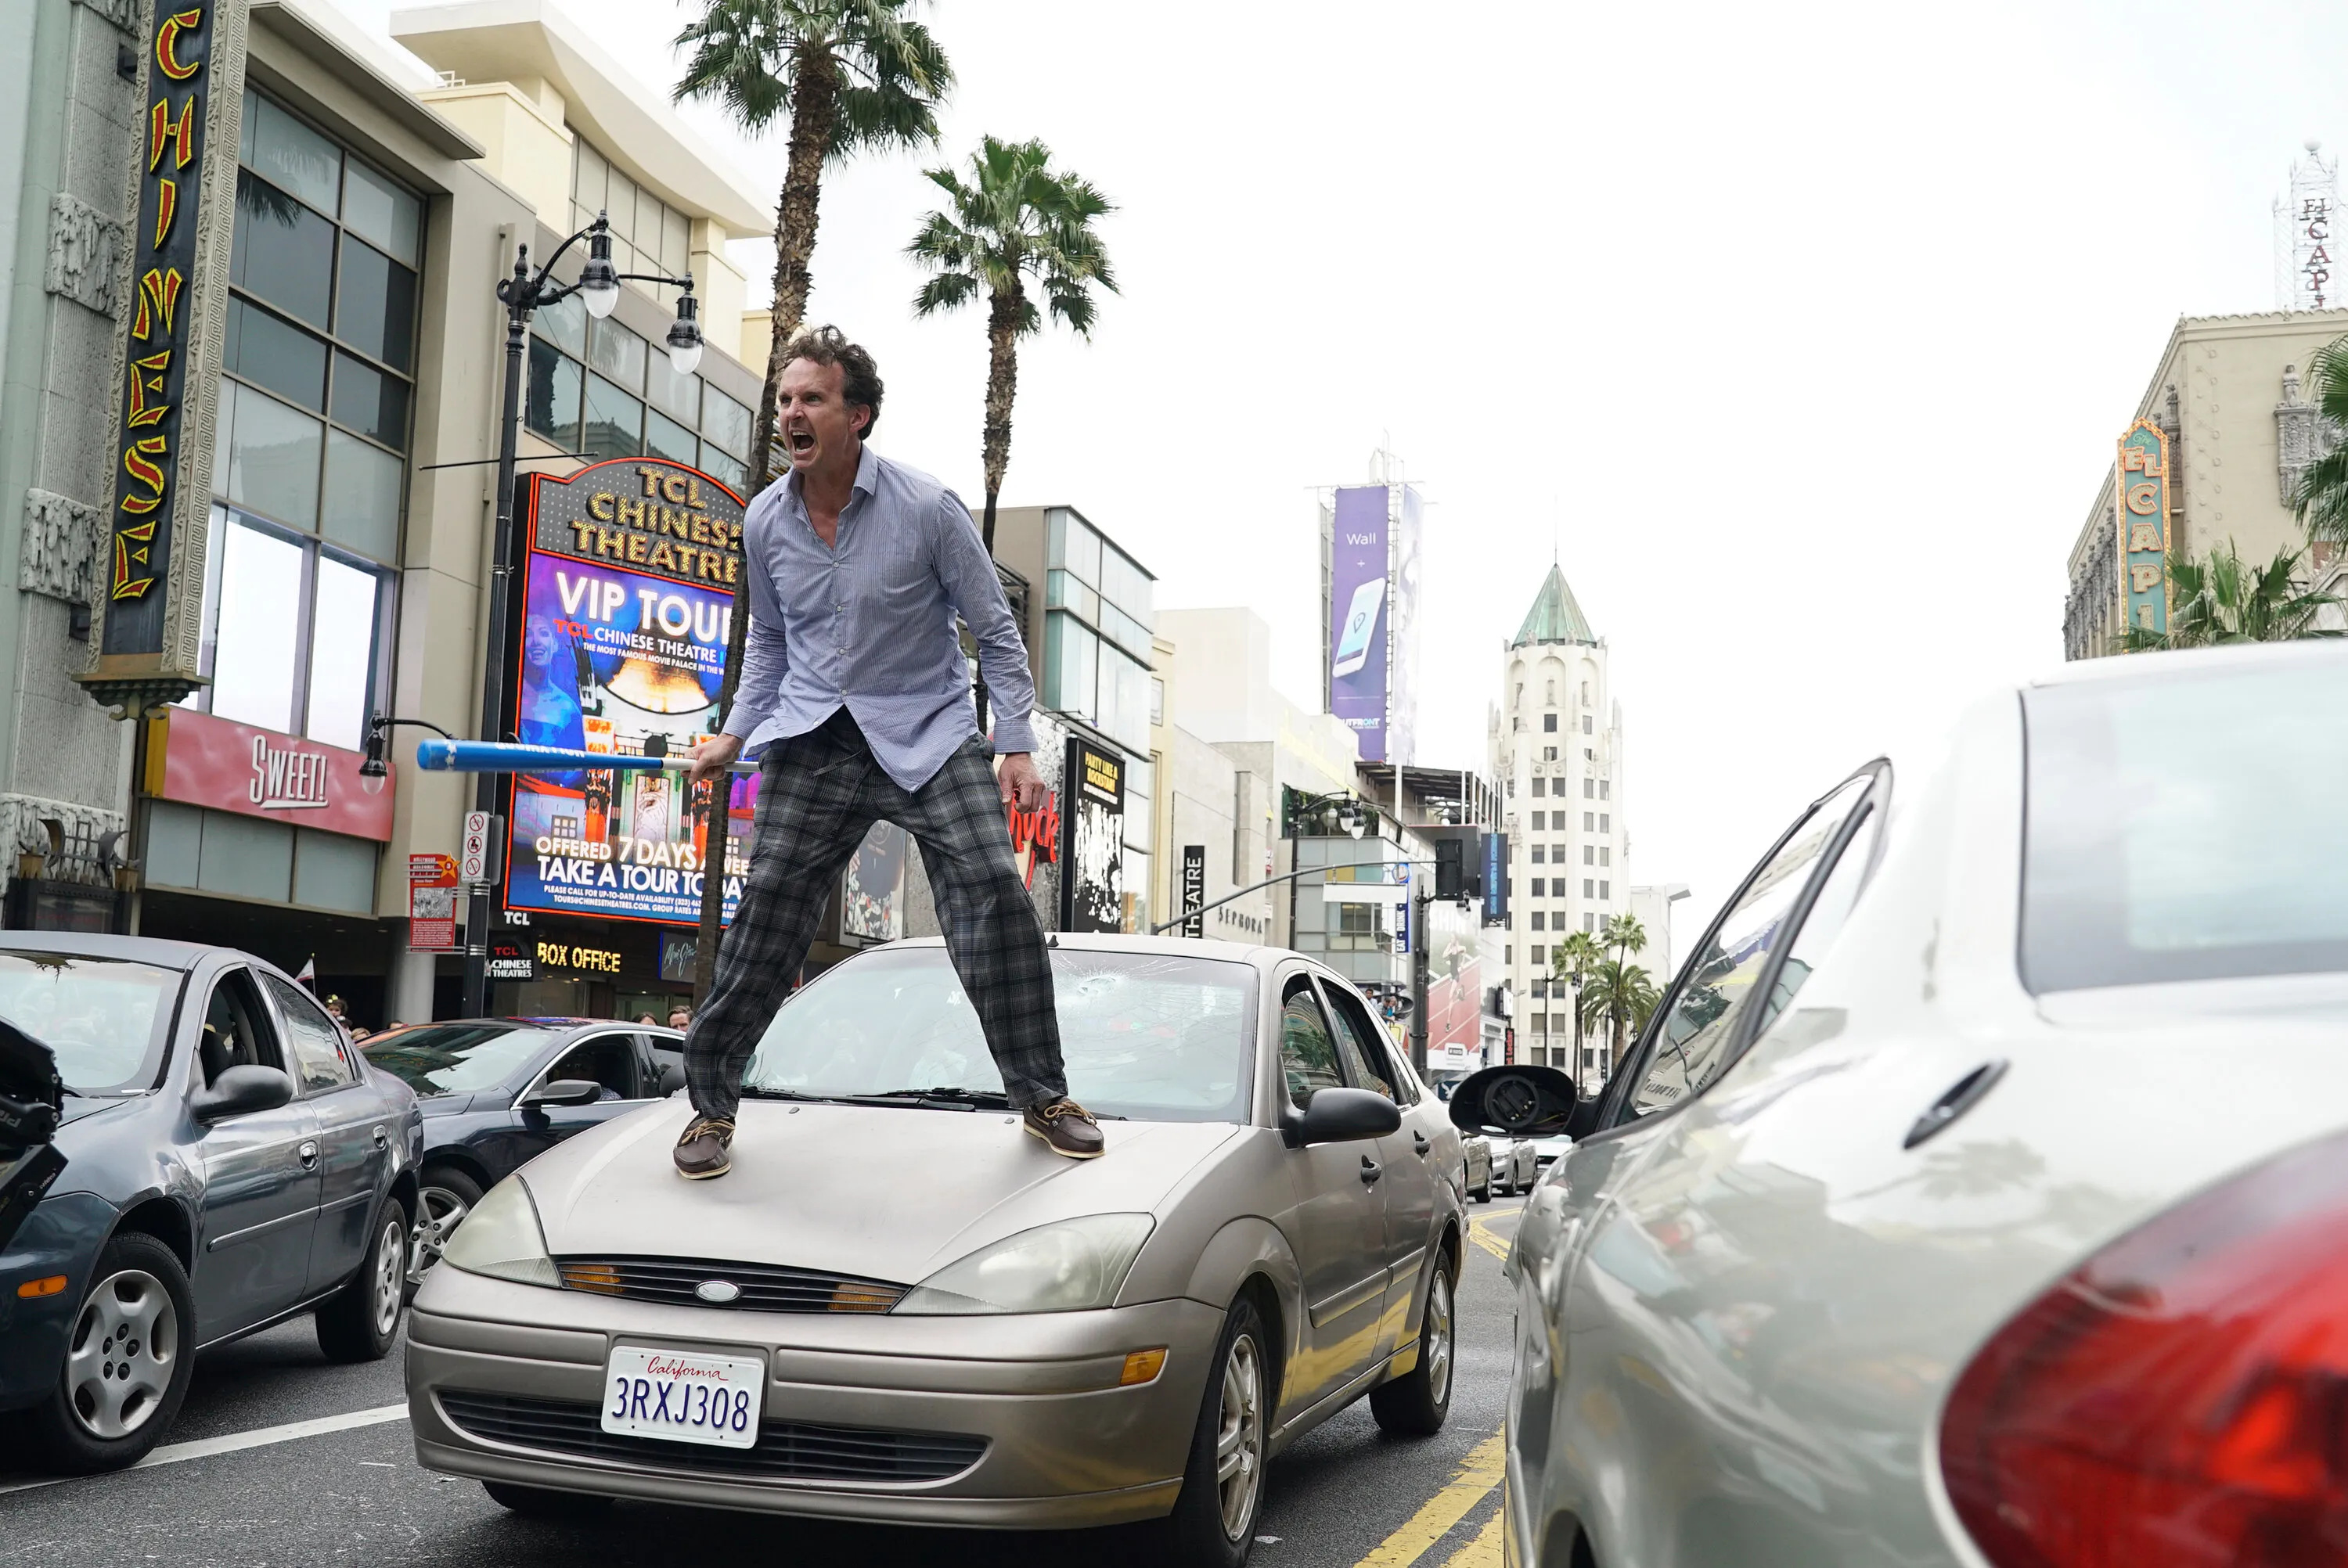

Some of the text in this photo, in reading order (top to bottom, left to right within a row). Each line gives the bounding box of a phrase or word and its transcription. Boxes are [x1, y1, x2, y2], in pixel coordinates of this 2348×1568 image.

[112, 6, 203, 602] CHINESE
[2124, 446, 2163, 477] EL
[638, 466, 706, 509] TCL
[1346, 533, 1376, 545] Wall
[556, 572, 625, 622] VIP
[553, 619, 593, 638] TCL
[593, 627, 654, 651] CHINESE
[657, 638, 717, 663] THEATRE
[583, 642, 596, 652] THE
[597, 645, 618, 656] MOST
[618, 649, 647, 661] FAMOUS
[648, 654, 670, 666] MOVIE
[672, 658, 697, 671] PALACE
[707, 665, 718, 674] THE
[535, 836, 611, 861] OFFERED
[618, 837, 635, 862] 7
[636, 839, 697, 870] DAYS
[537, 854, 594, 886] TAKE
[597, 862, 618, 887] A
[621, 865, 679, 894] TOUR
[544, 885, 567, 894] PLEASE
[567, 887, 584, 897] CALL
[585, 889, 597, 897] FOR
[599, 890, 635, 901] UP-TO-DATE
[636, 894, 675, 905] AVAILABILITY
[652, 904, 673, 913] GROUP
[675, 906, 691, 915] RATES
[1185, 857, 1201, 938] THEATRE
[504, 911, 530, 926] TCL
[1219, 906, 1262, 934] SEPHORA
[1396, 910, 1406, 951] EAT DRINK
[492, 959, 532, 969] CHINESE
[494, 947, 519, 956] TCL
[537, 942, 621, 973] BOX OFFICE
[647, 1355, 729, 1382] California
[611, 1377, 750, 1432] 3RXJ308
